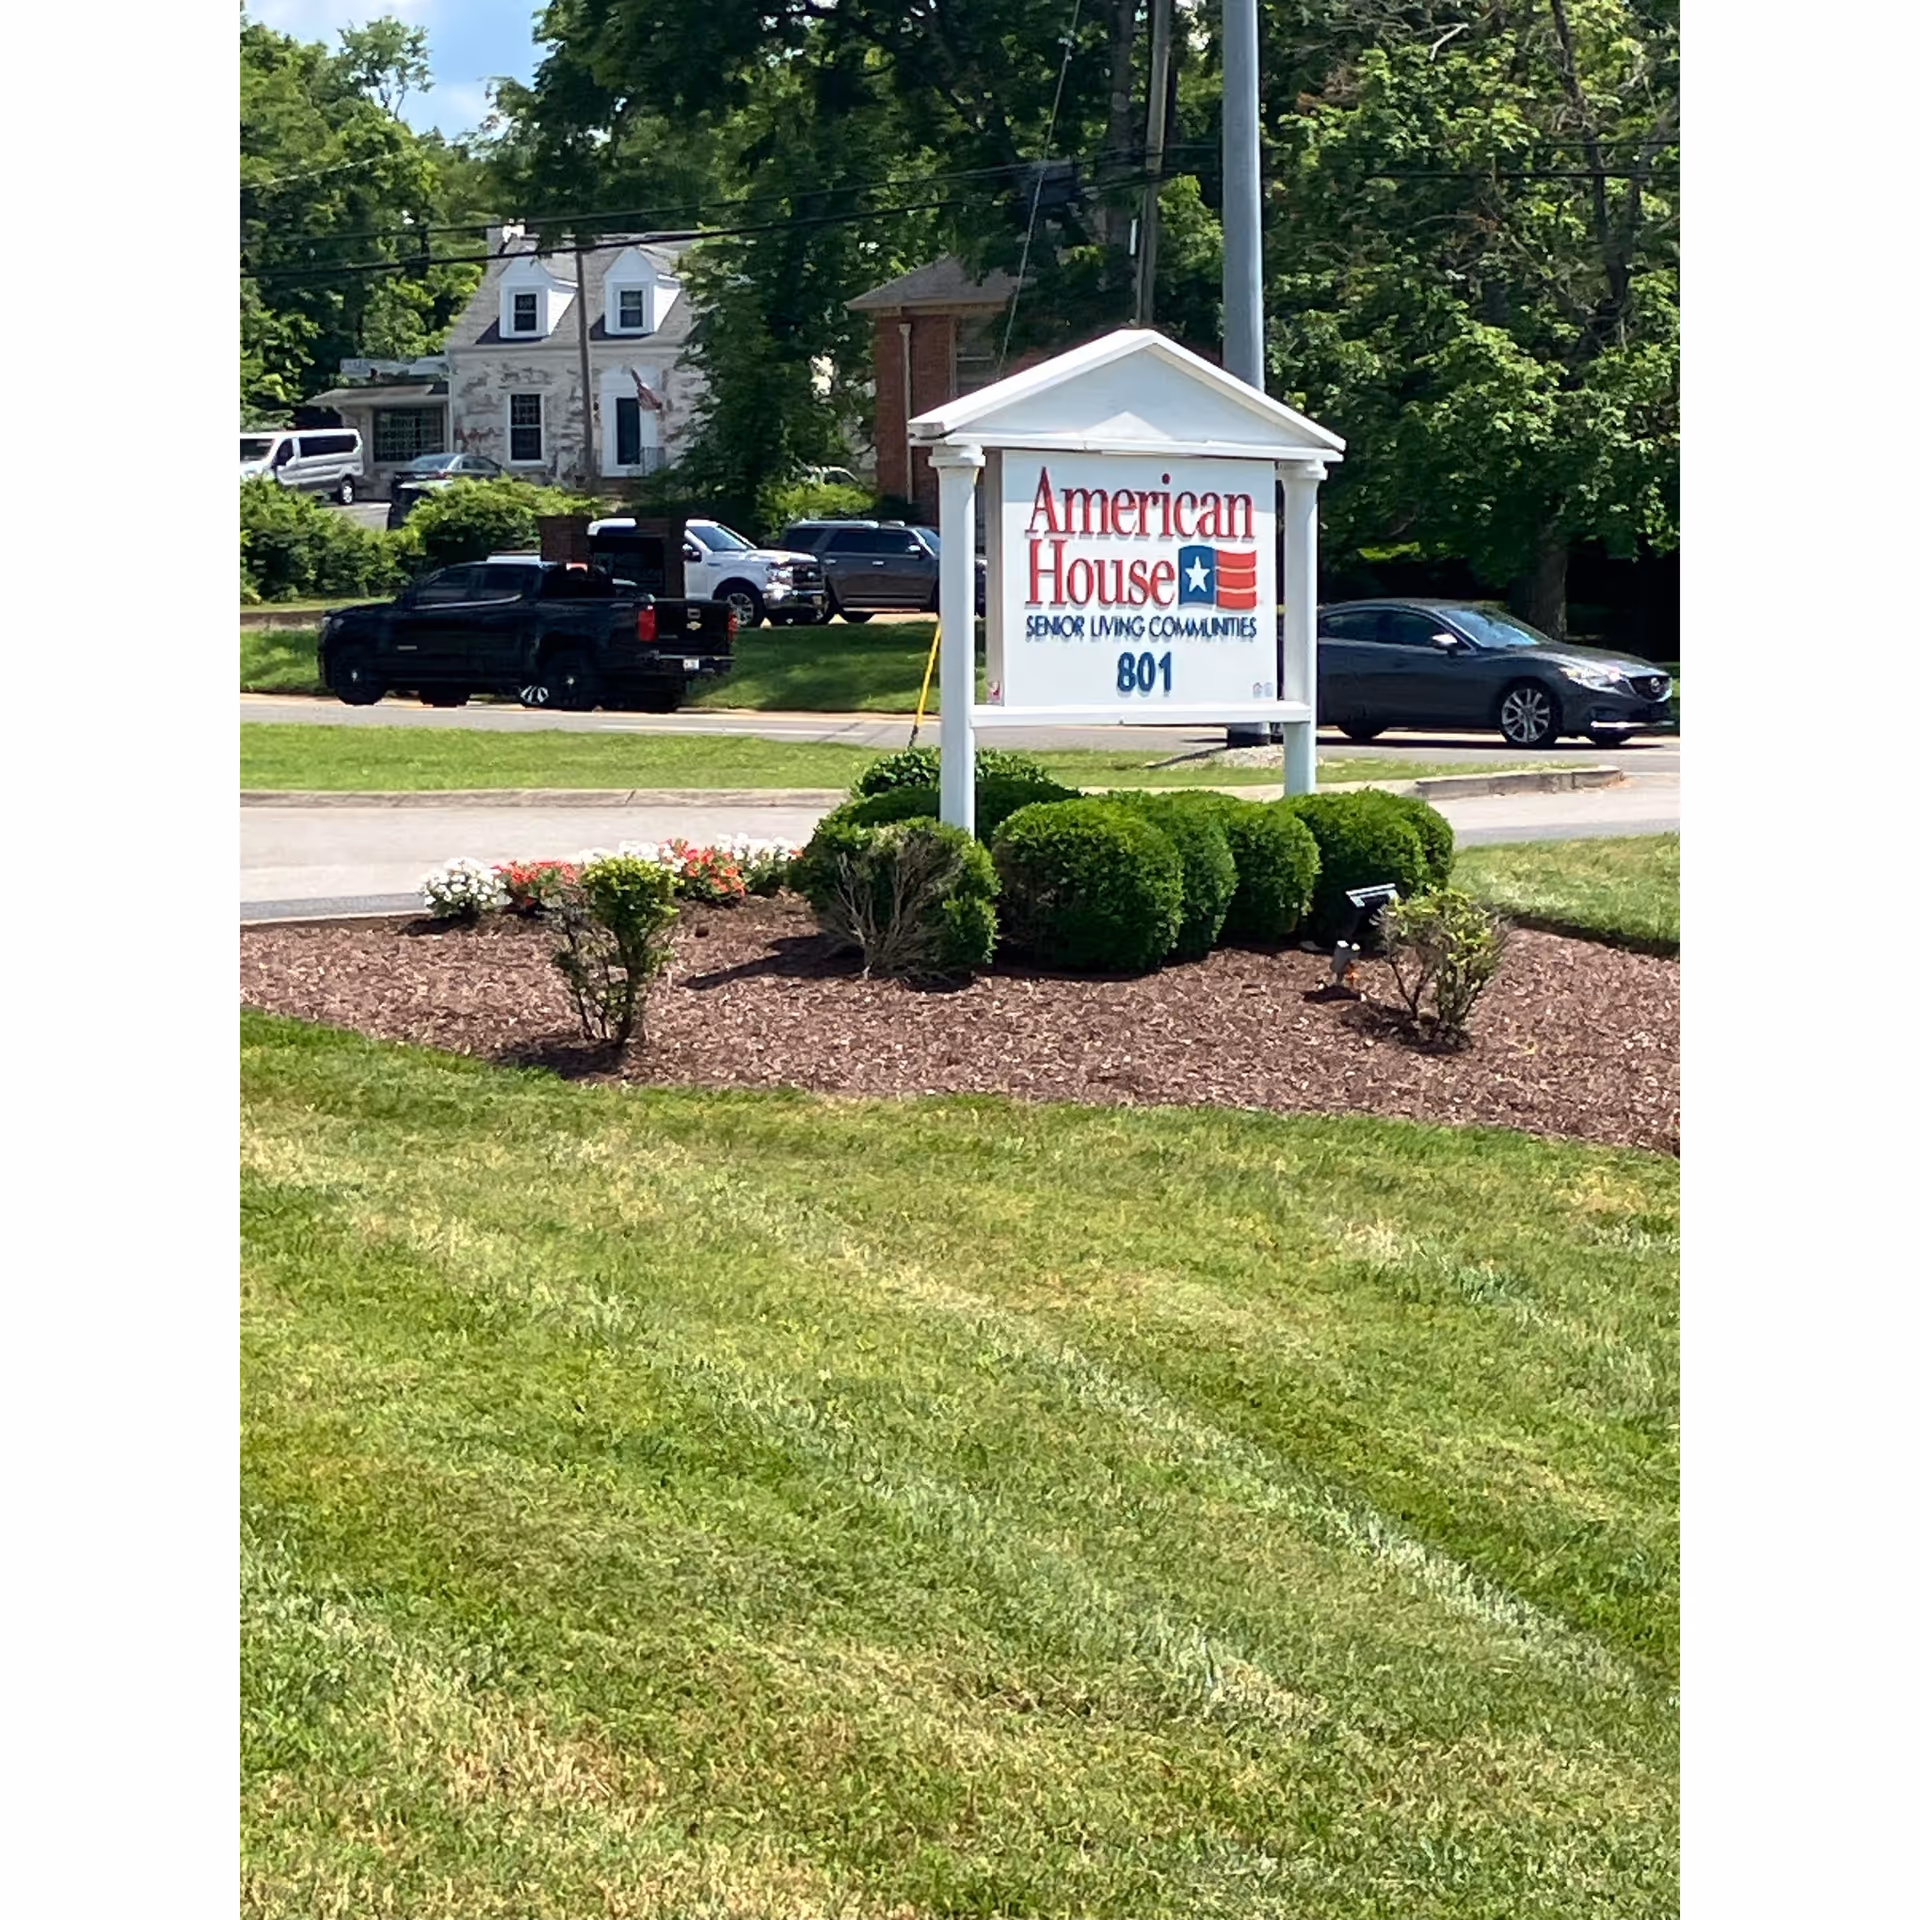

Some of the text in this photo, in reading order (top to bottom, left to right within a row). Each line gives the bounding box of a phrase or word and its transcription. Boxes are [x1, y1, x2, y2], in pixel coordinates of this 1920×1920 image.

[1025, 466, 1255, 539] American
[1025, 538, 1175, 606] House
[1026, 615, 1257, 638] SENIOR LIVING COMMUNITIES
[1117, 651, 1172, 692] 801
